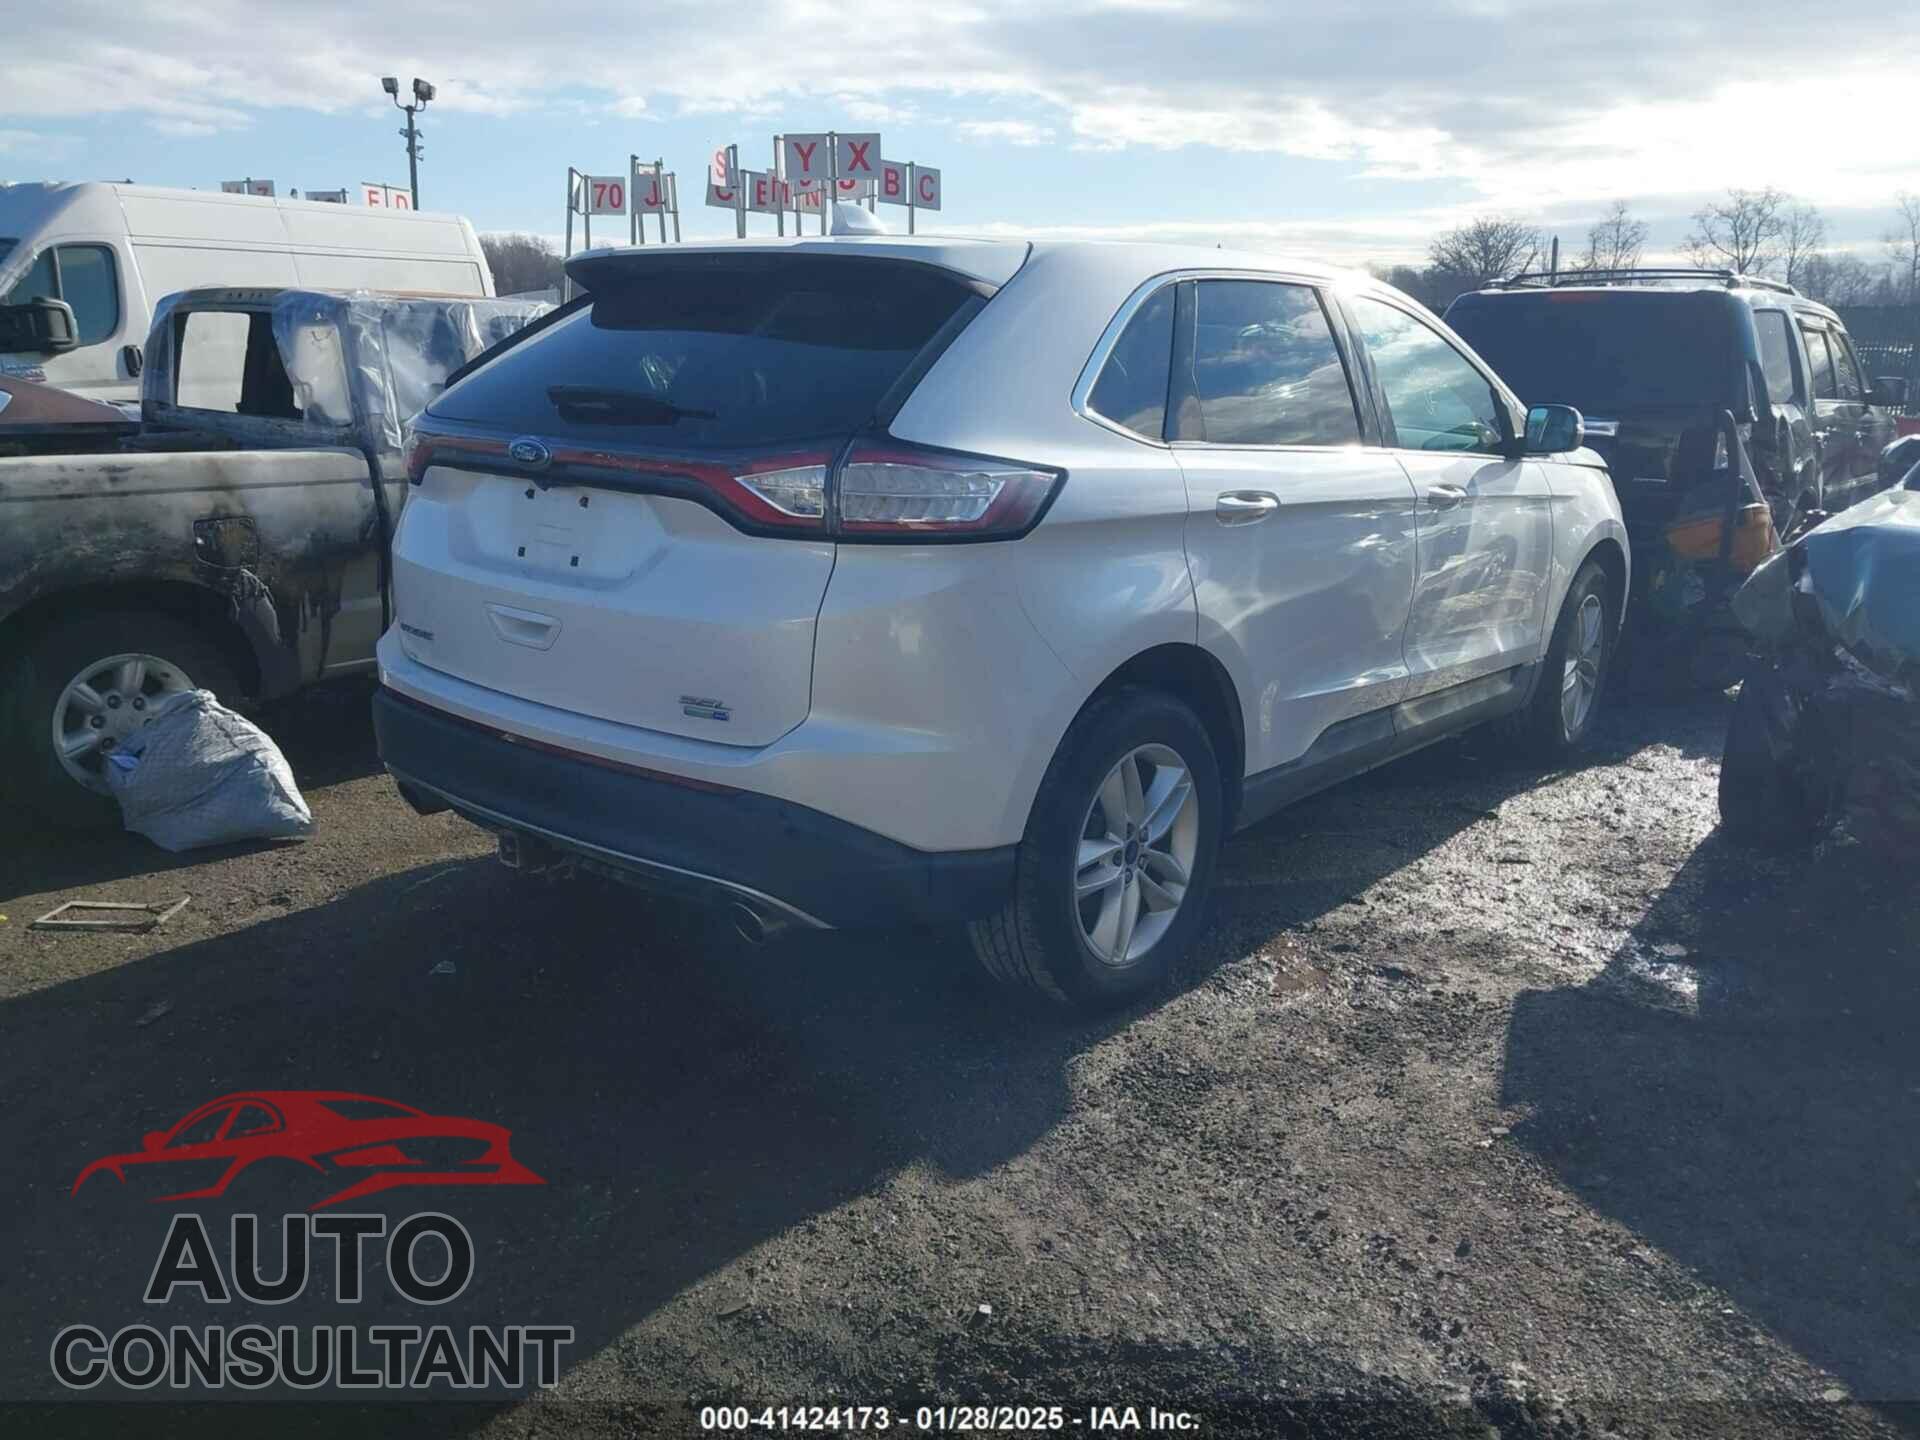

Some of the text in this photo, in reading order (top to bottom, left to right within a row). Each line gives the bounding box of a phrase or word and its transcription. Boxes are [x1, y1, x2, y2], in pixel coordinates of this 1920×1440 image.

[794, 142, 817, 172] Y
[848, 141, 871, 172] X
[644, 180, 659, 206] J
[884, 167, 900, 196] B
[919, 174, 935, 202] C
[594, 183, 623, 209] 70
